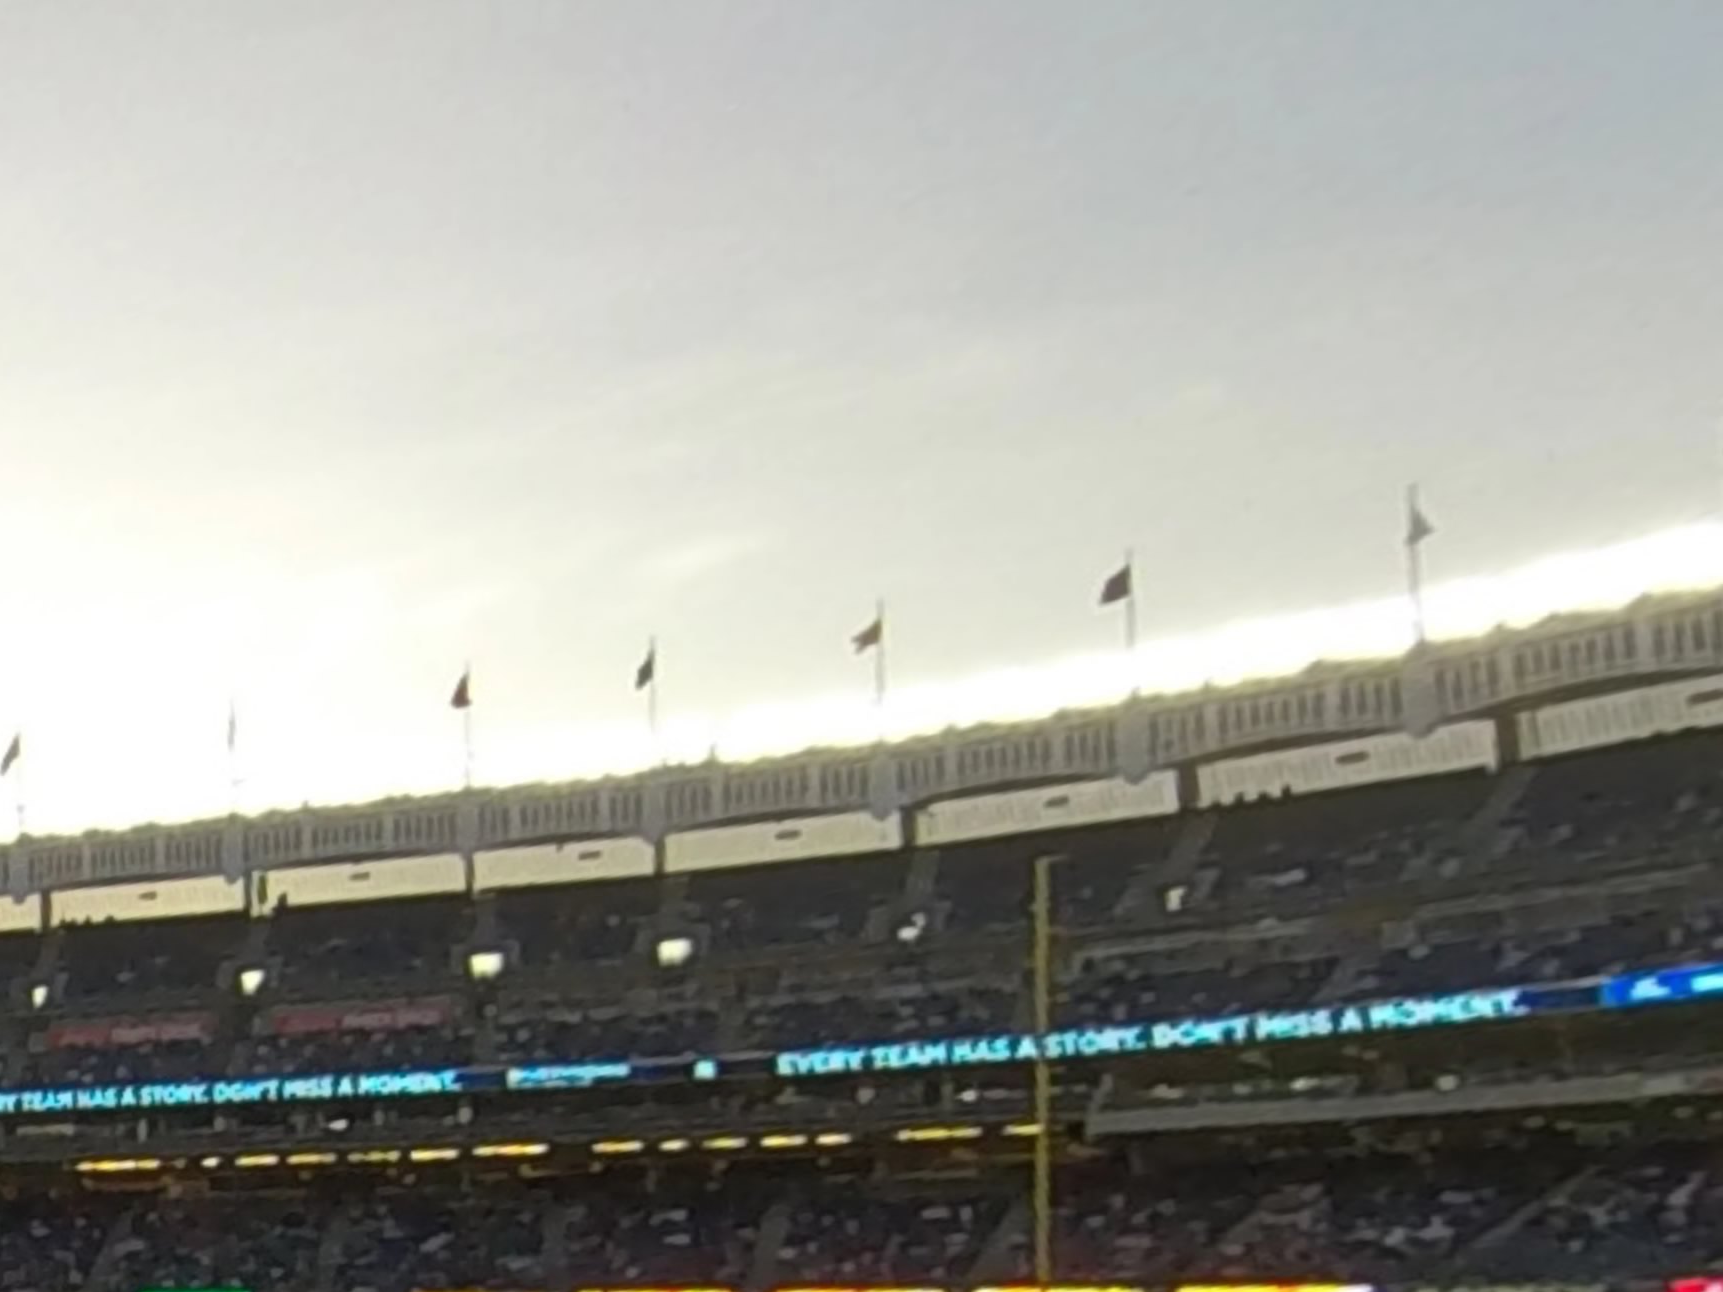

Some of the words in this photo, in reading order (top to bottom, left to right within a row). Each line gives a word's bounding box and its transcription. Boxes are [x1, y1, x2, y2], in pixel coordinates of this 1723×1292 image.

[777, 1047, 862, 1076] EVERY
[872, 1043, 946, 1070] TEAM
[952, 1037, 1013, 1064] HAS
[1015, 1036, 1037, 1060] A
[1042, 1021, 1147, 1057] STORY.
[1153, 1013, 1249, 1049] DON'T
[1256, 1008, 1333, 1041] MISS
[1336, 1005, 1360, 1034] A
[1370, 989, 1532, 1030] MOMENT.
[21, 1089, 73, 1113] TEAM
[78, 1086, 117, 1109] HAS
[121, 1085, 137, 1107] A
[140, 1082, 207, 1107] STORY.
[212, 1079, 279, 1102] DON'T
[284, 1076, 333, 1100] MISS
[338, 1074, 355, 1097] A
[357, 1069, 463, 1096] MOMENT.
